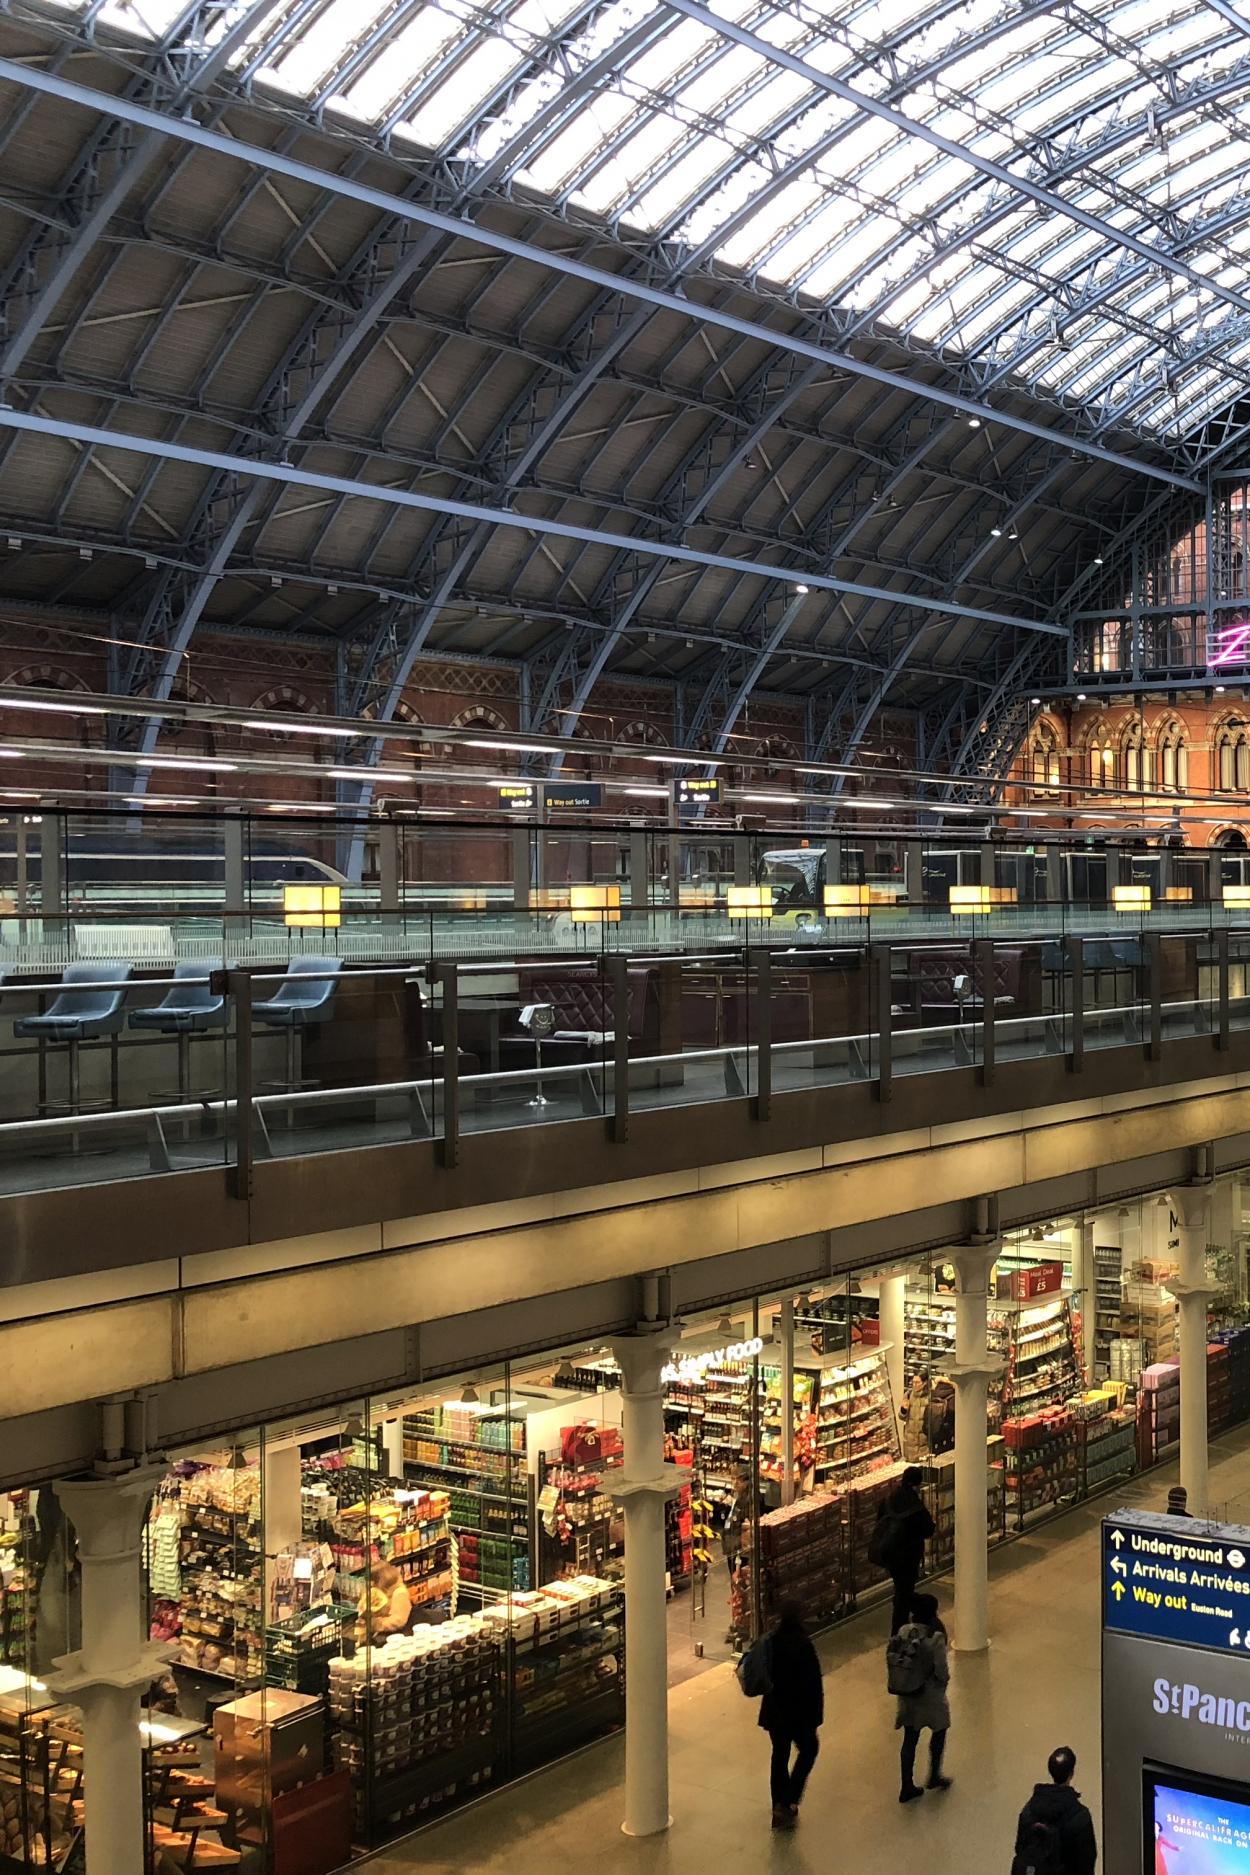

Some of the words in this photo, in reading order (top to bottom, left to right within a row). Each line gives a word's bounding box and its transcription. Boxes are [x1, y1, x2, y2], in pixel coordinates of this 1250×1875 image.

[1036, 1281, 1046, 1292] £5
[726, 1337, 764, 1361] FOOD
[1131, 1534, 1223, 1564] Underground
[1132, 1560, 1187, 1584] Arrivals
[1190, 1569, 1250, 1595] Arrivées
[1133, 1586, 1162, 1608] Way
[1164, 1594, 1188, 1610] out
[1191, 1603, 1214, 1615] Euston
[1215, 1607, 1233, 1618] Road
[1218, 1816, 1230, 1826] THE
[1173, 1825, 1210, 1840] ORIGINAL
[1213, 1835, 1233, 1846] BACK
[1236, 1840, 1248, 1849] ON
